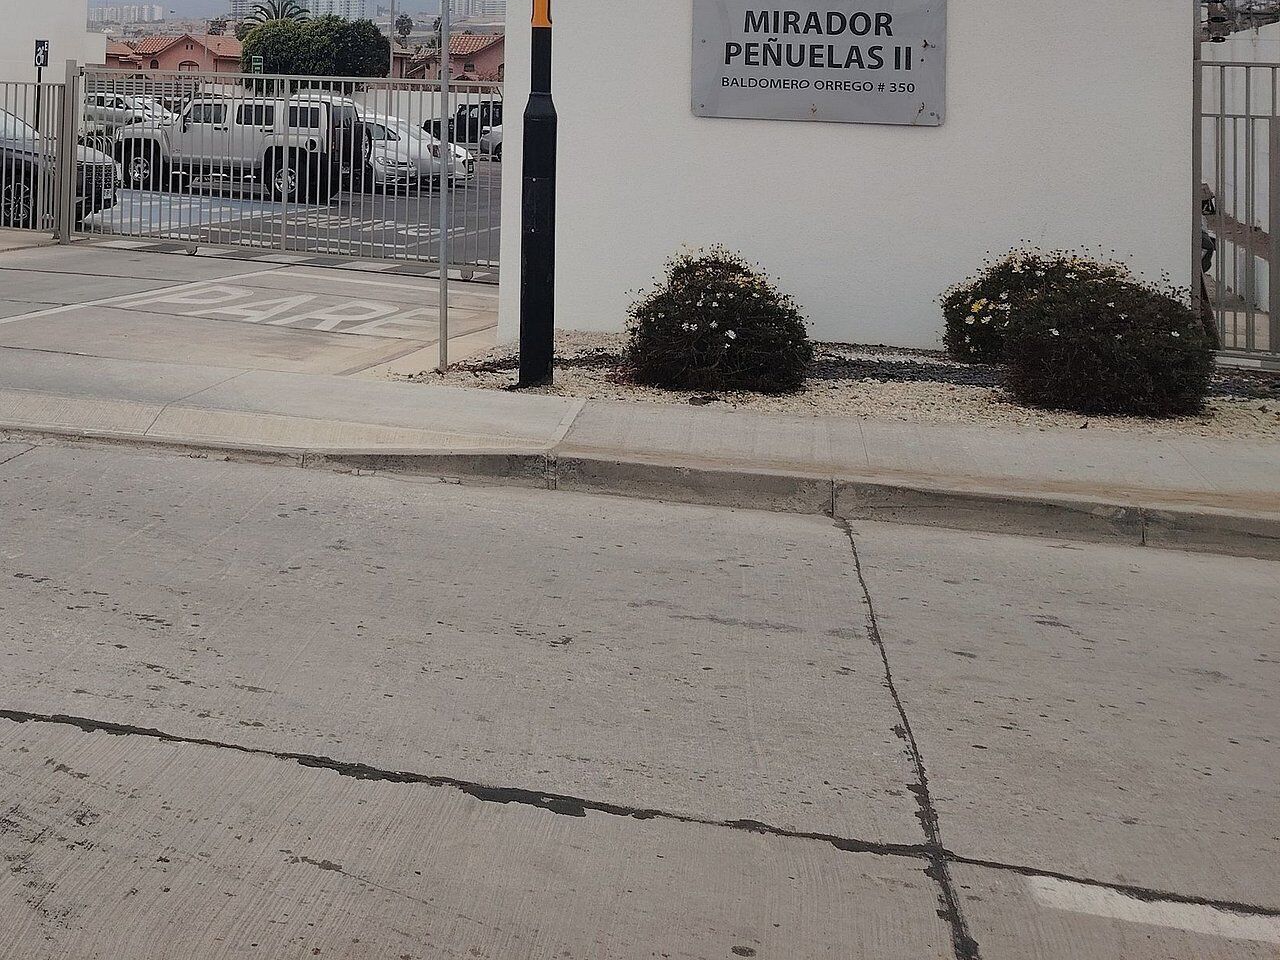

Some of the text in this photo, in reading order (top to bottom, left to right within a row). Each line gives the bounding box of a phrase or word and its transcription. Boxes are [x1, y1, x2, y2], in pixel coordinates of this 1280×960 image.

[743, 10, 894, 37] MIRADOR
[724, 37, 912, 71] PEÑUELAS II
[721, 76, 915, 94] BALDOMERO ORREGO # 350
[111, 285, 478, 336] PARE
